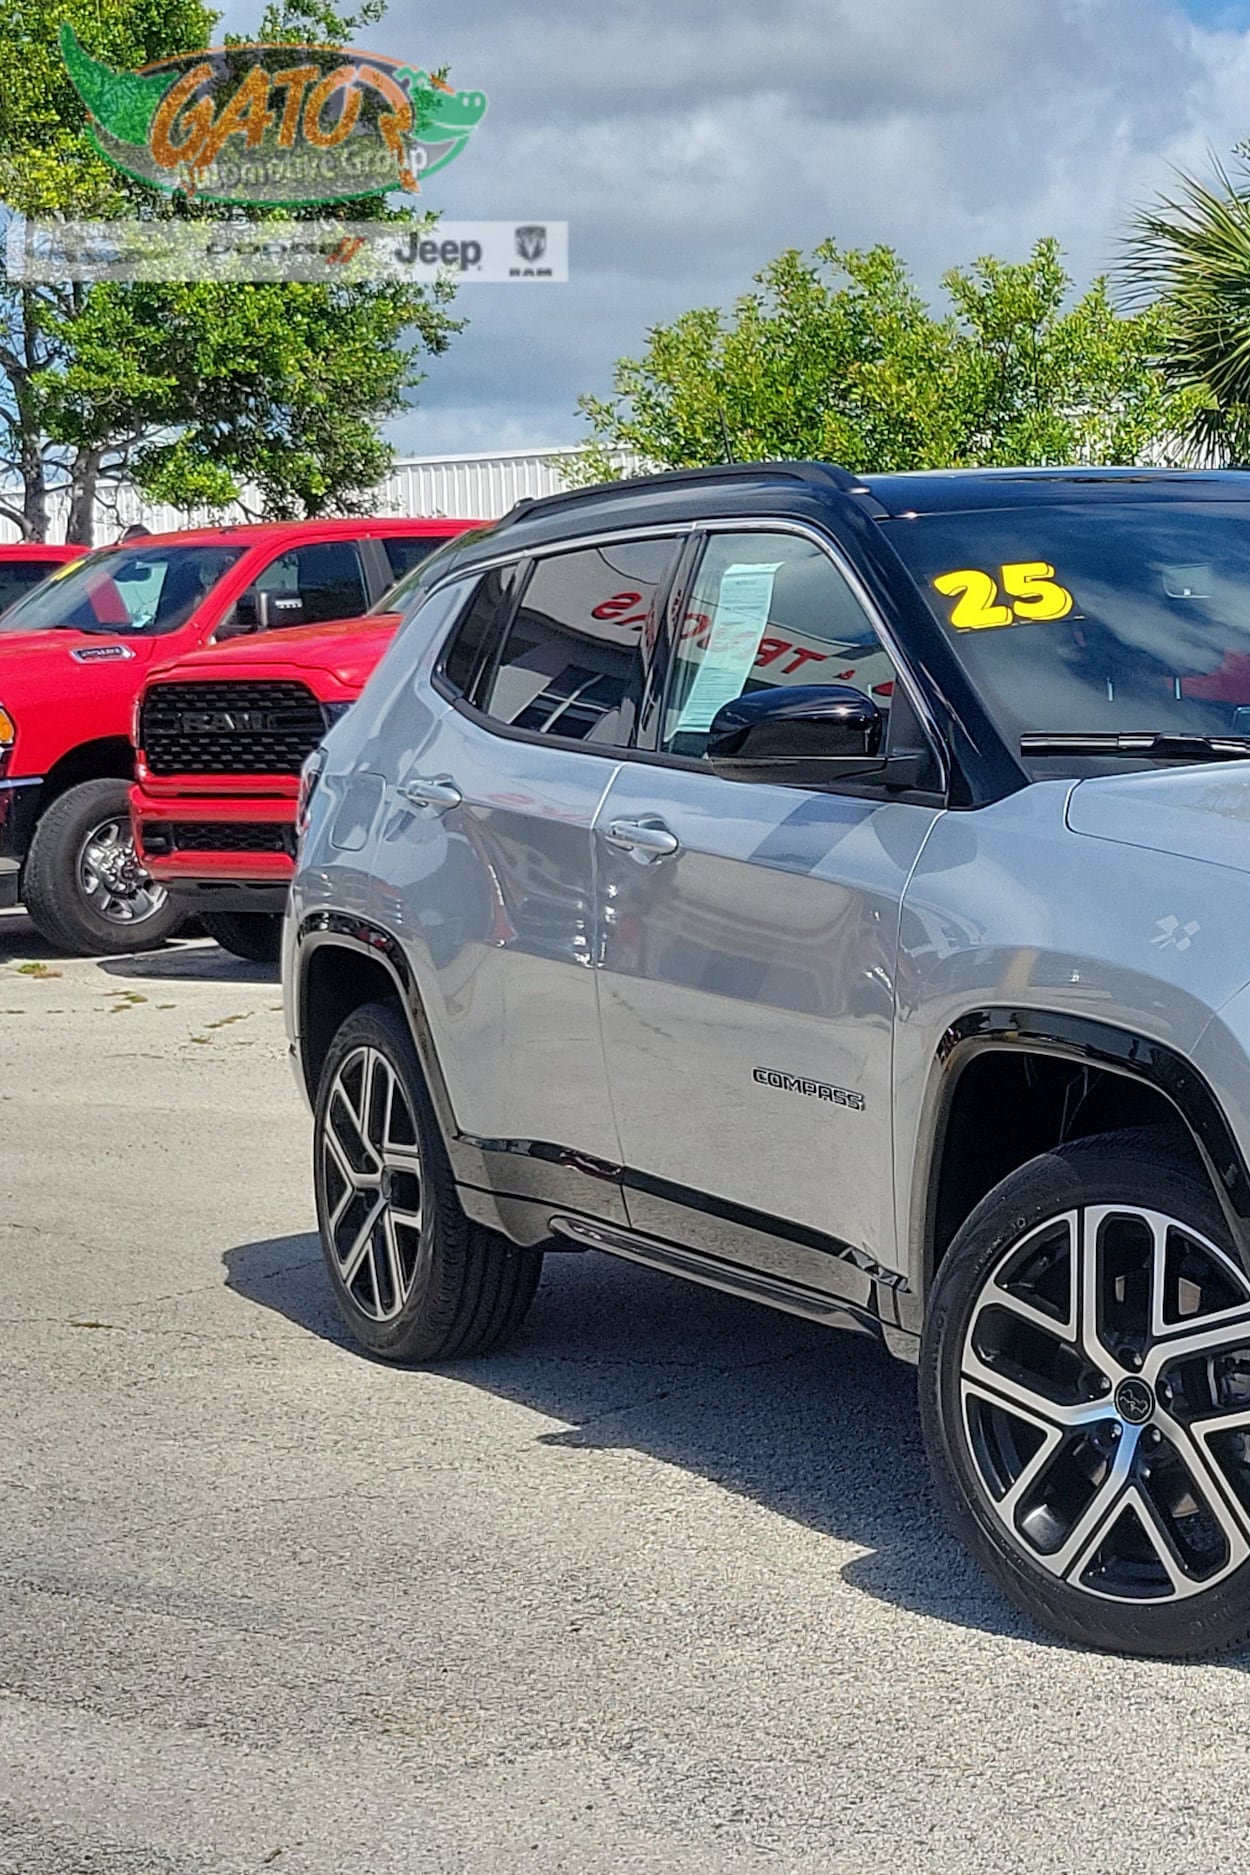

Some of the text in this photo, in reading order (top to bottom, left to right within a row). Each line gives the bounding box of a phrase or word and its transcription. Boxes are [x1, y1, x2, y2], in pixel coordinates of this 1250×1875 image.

[933, 561, 1074, 630] 25
[183, 711, 263, 733] RAM
[752, 1066, 865, 1111] COMPASS
